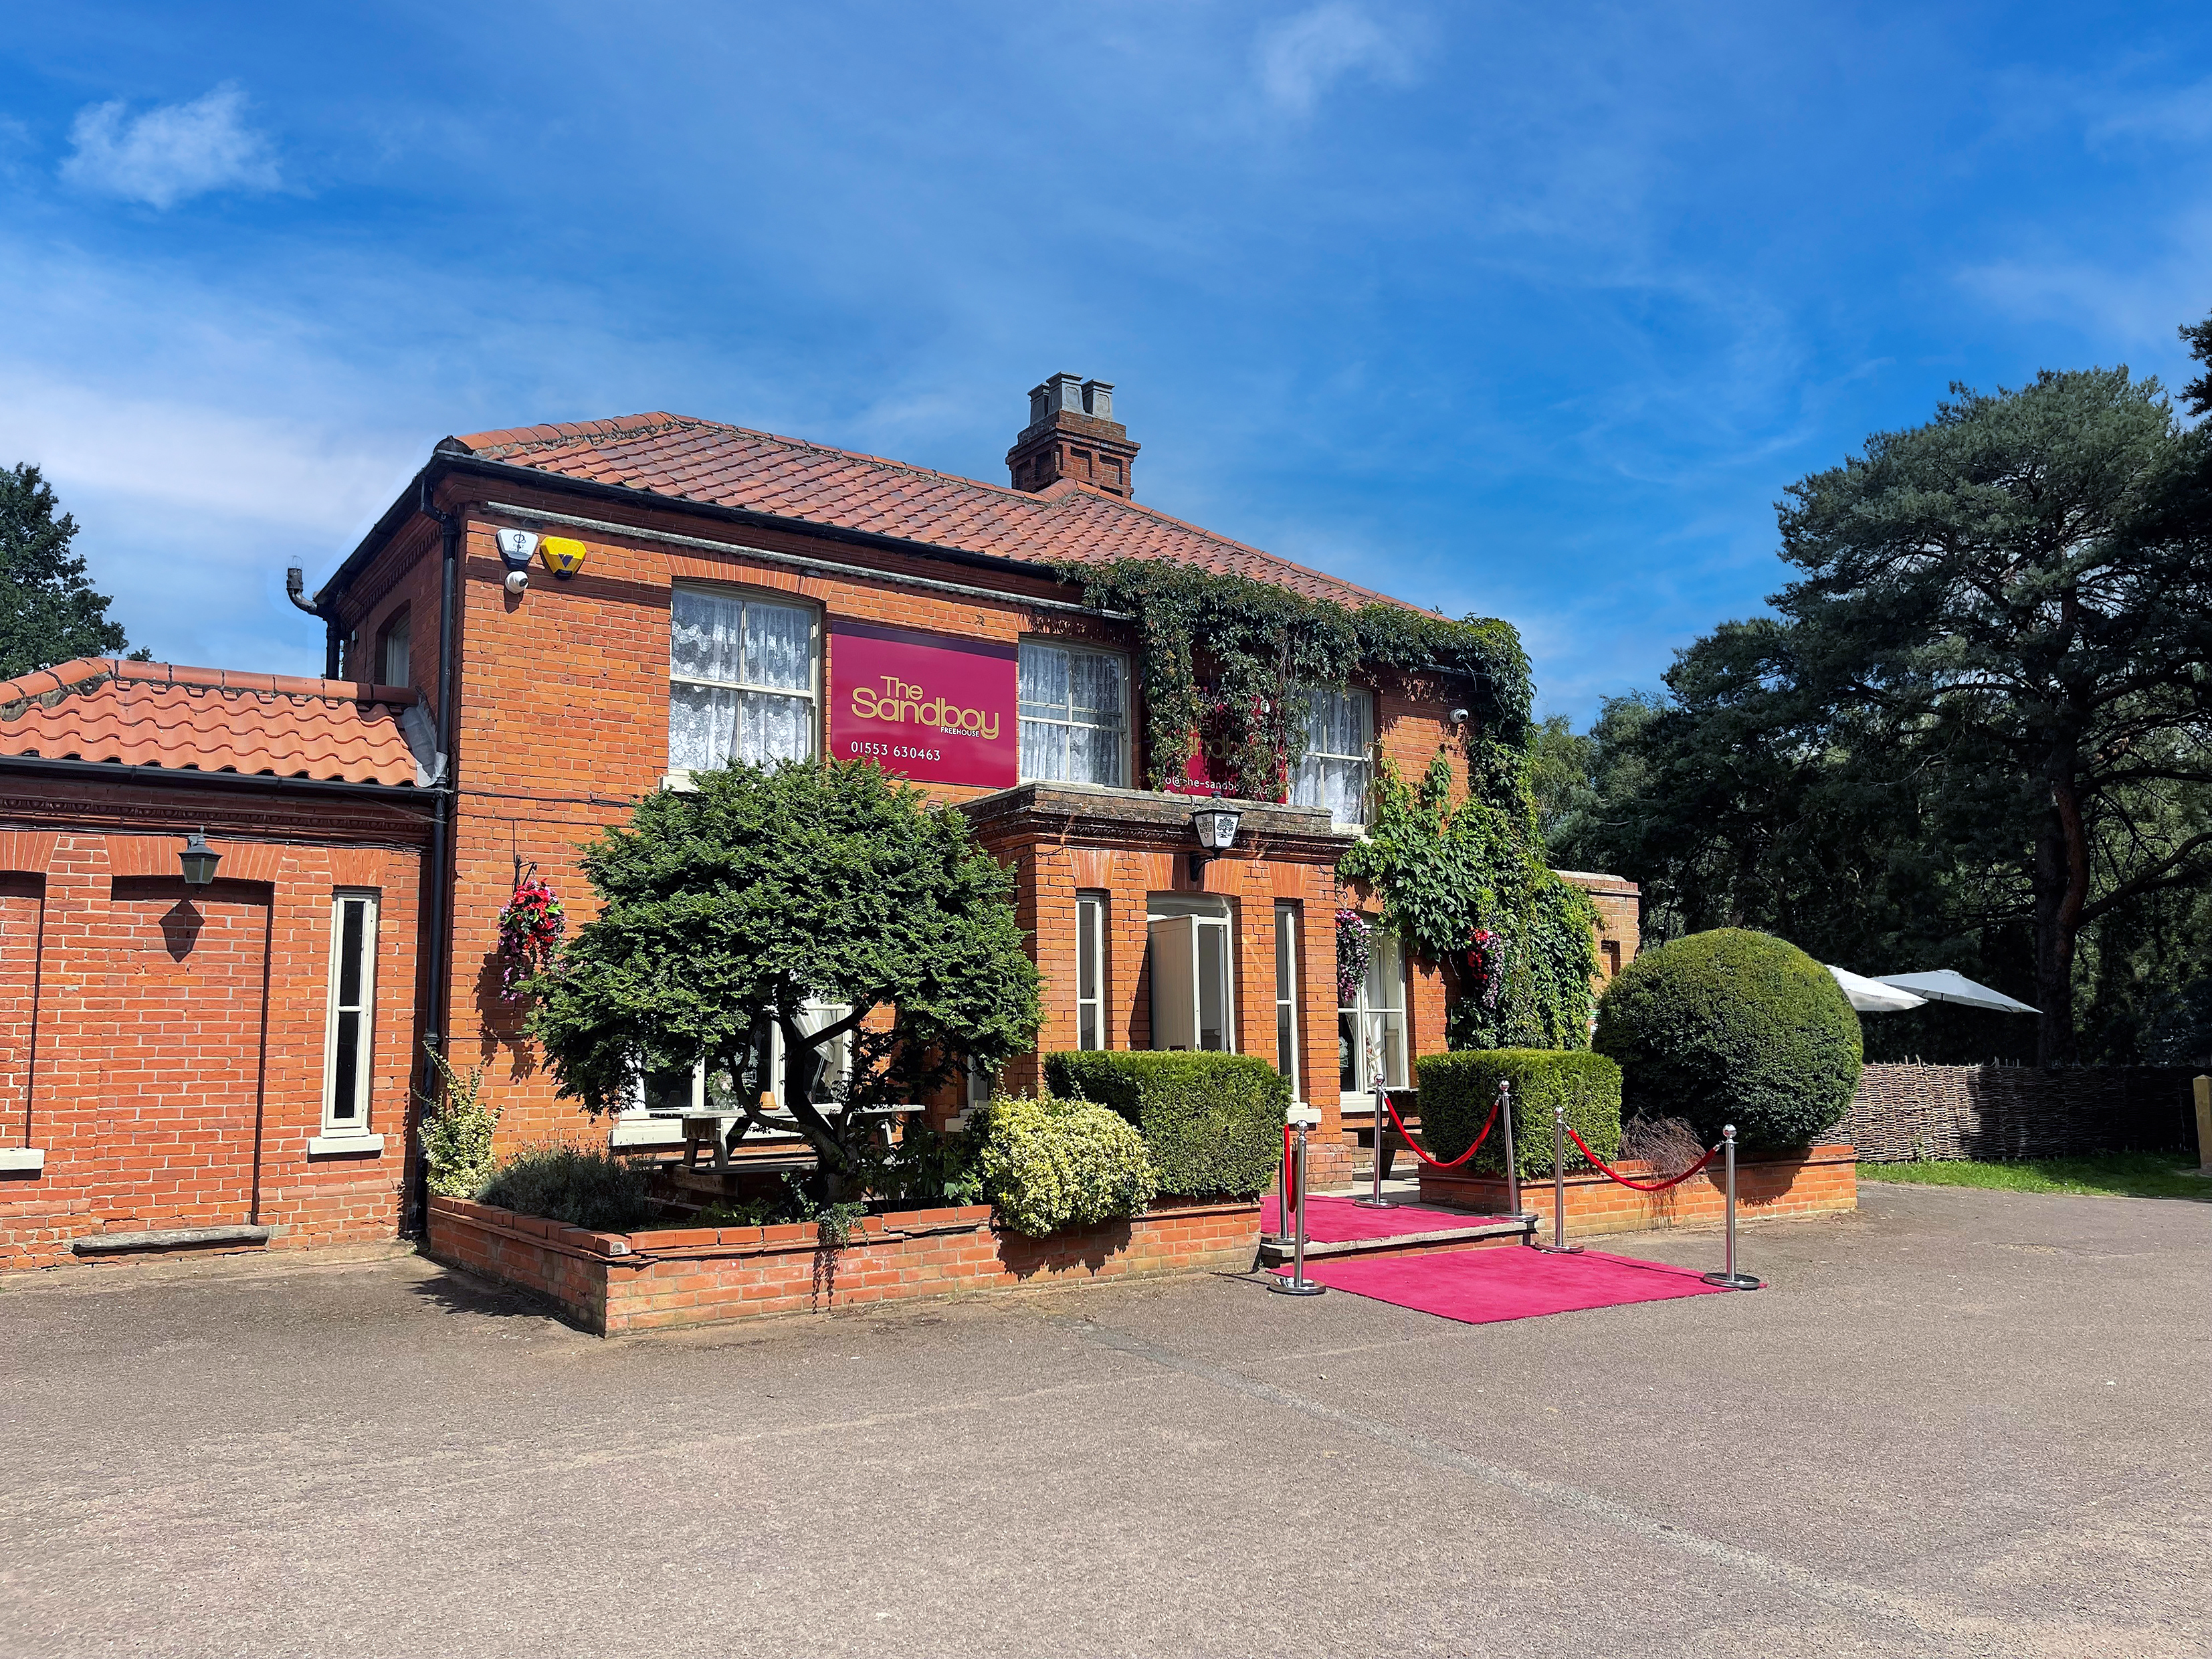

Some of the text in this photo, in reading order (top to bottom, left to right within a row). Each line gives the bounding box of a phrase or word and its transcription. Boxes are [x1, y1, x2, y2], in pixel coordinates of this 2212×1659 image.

[880, 675, 923, 700] The
[851, 686, 999, 740] Sandboy
[940, 726, 980, 738] FREEHOUSE
[850, 741, 941, 761] 01553 630463
